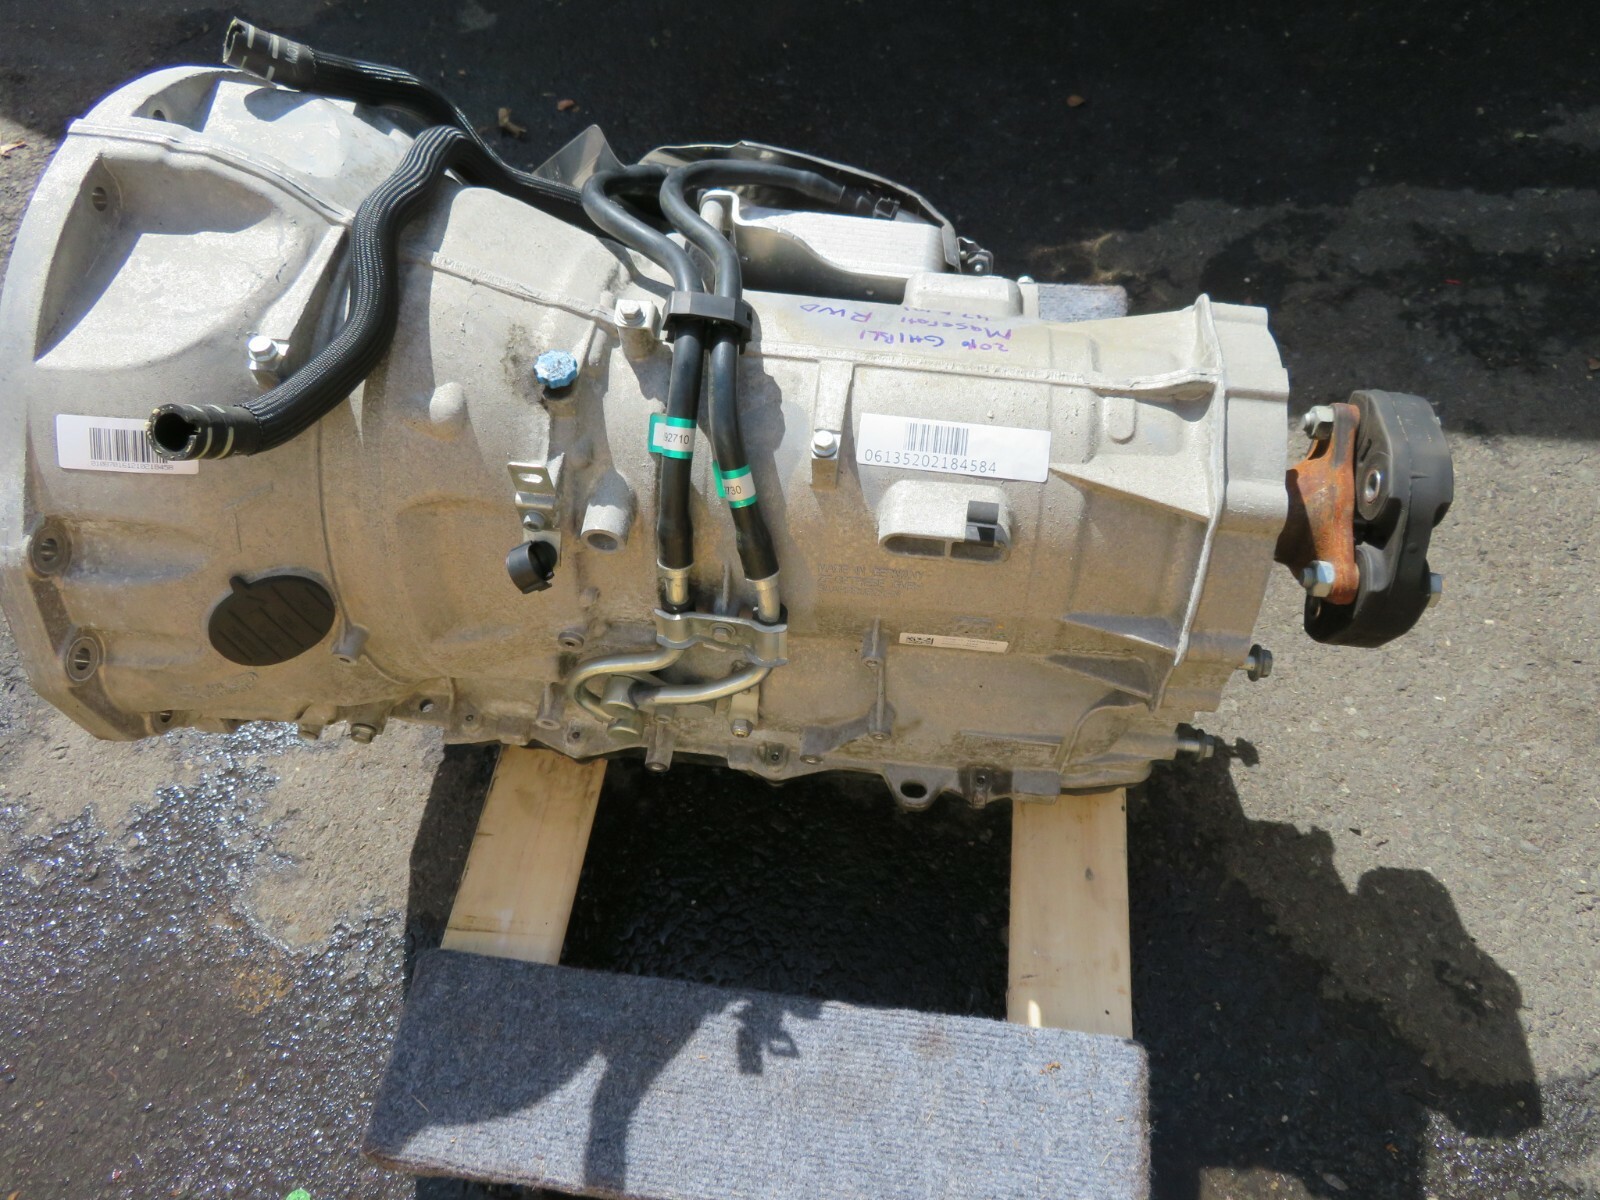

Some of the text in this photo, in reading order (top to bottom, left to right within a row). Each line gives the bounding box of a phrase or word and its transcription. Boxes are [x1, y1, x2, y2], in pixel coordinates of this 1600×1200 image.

[799, 303, 873, 323] RWD
[859, 329, 945, 348] GHIBLI
[663, 432, 690, 445] 92710
[864, 449, 997, 474] 06135202184584
